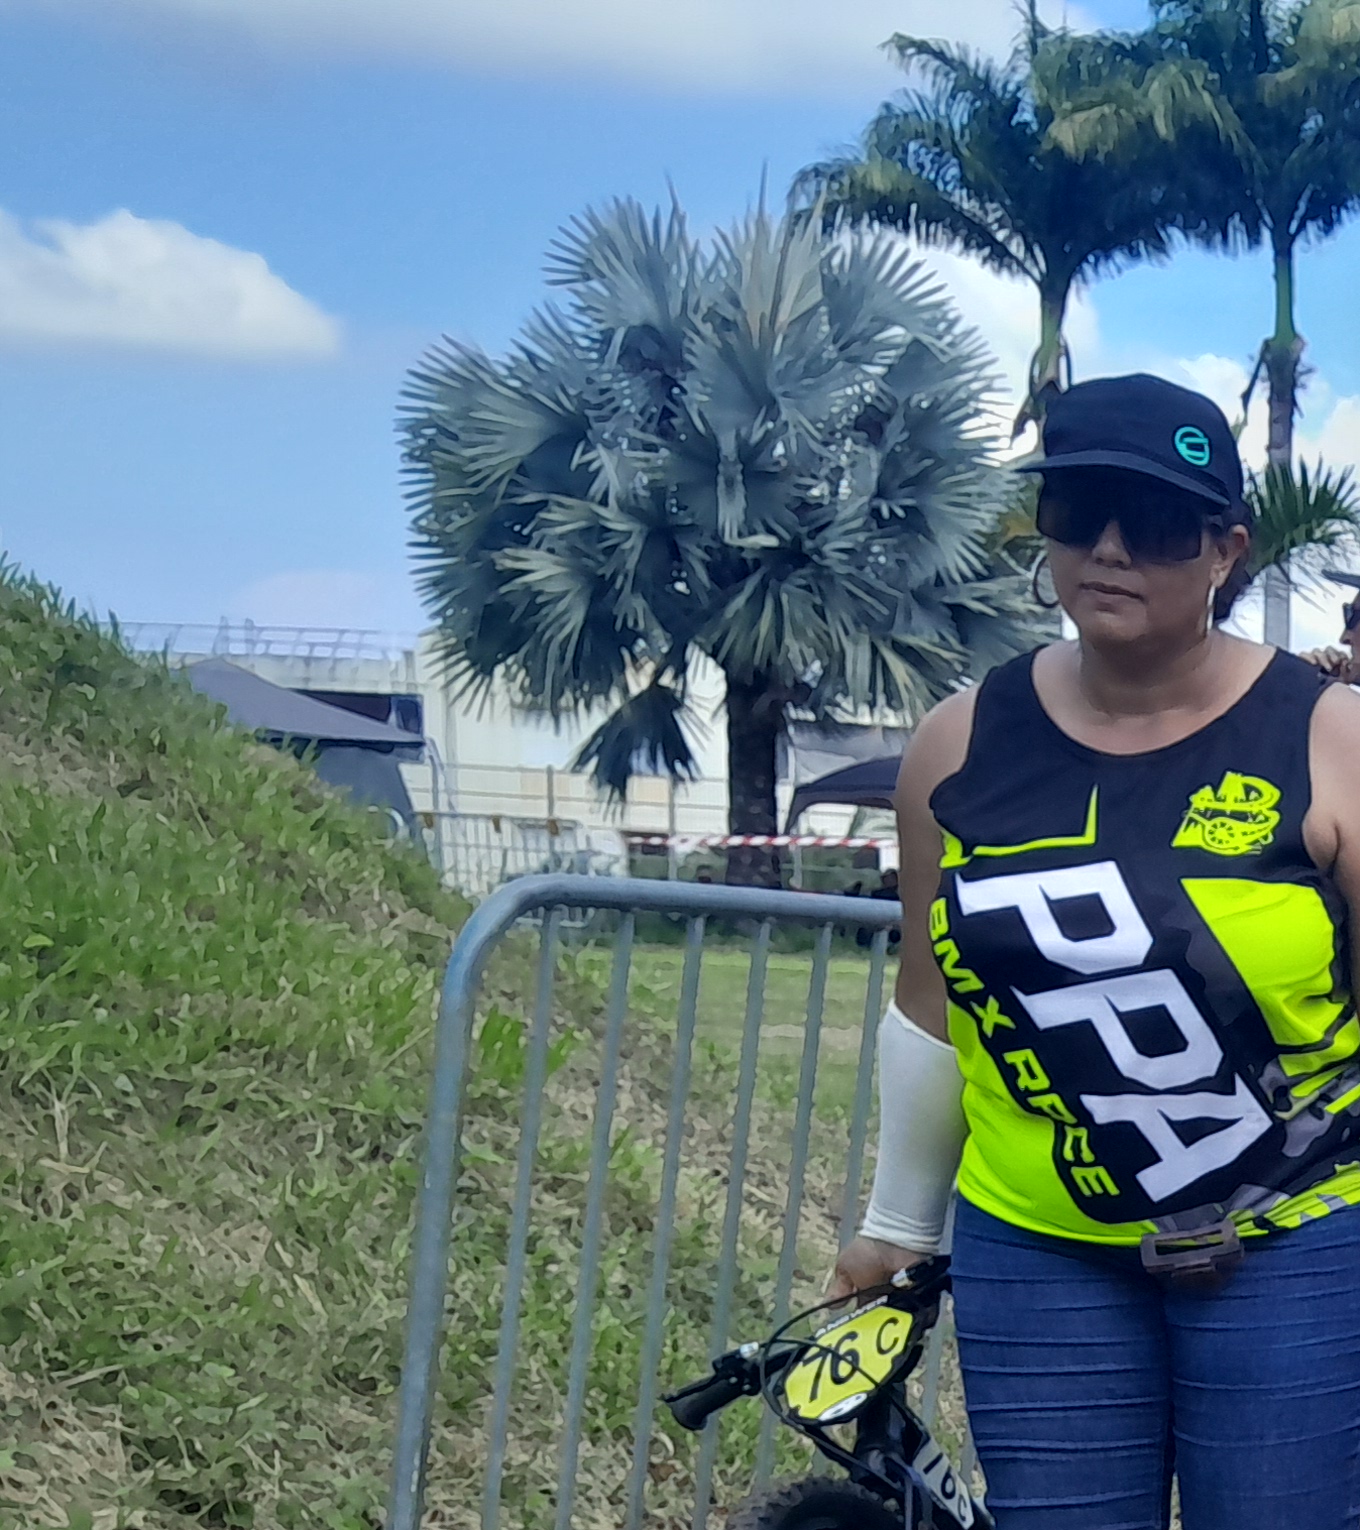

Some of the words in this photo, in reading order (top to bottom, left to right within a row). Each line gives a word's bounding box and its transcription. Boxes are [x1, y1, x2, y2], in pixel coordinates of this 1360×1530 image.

[929, 897, 1016, 1039] BMX
[1002, 1048, 1121, 1198] RACE
[955, 860, 1274, 1203] PPA
[801, 1330, 861, 1404] 76
